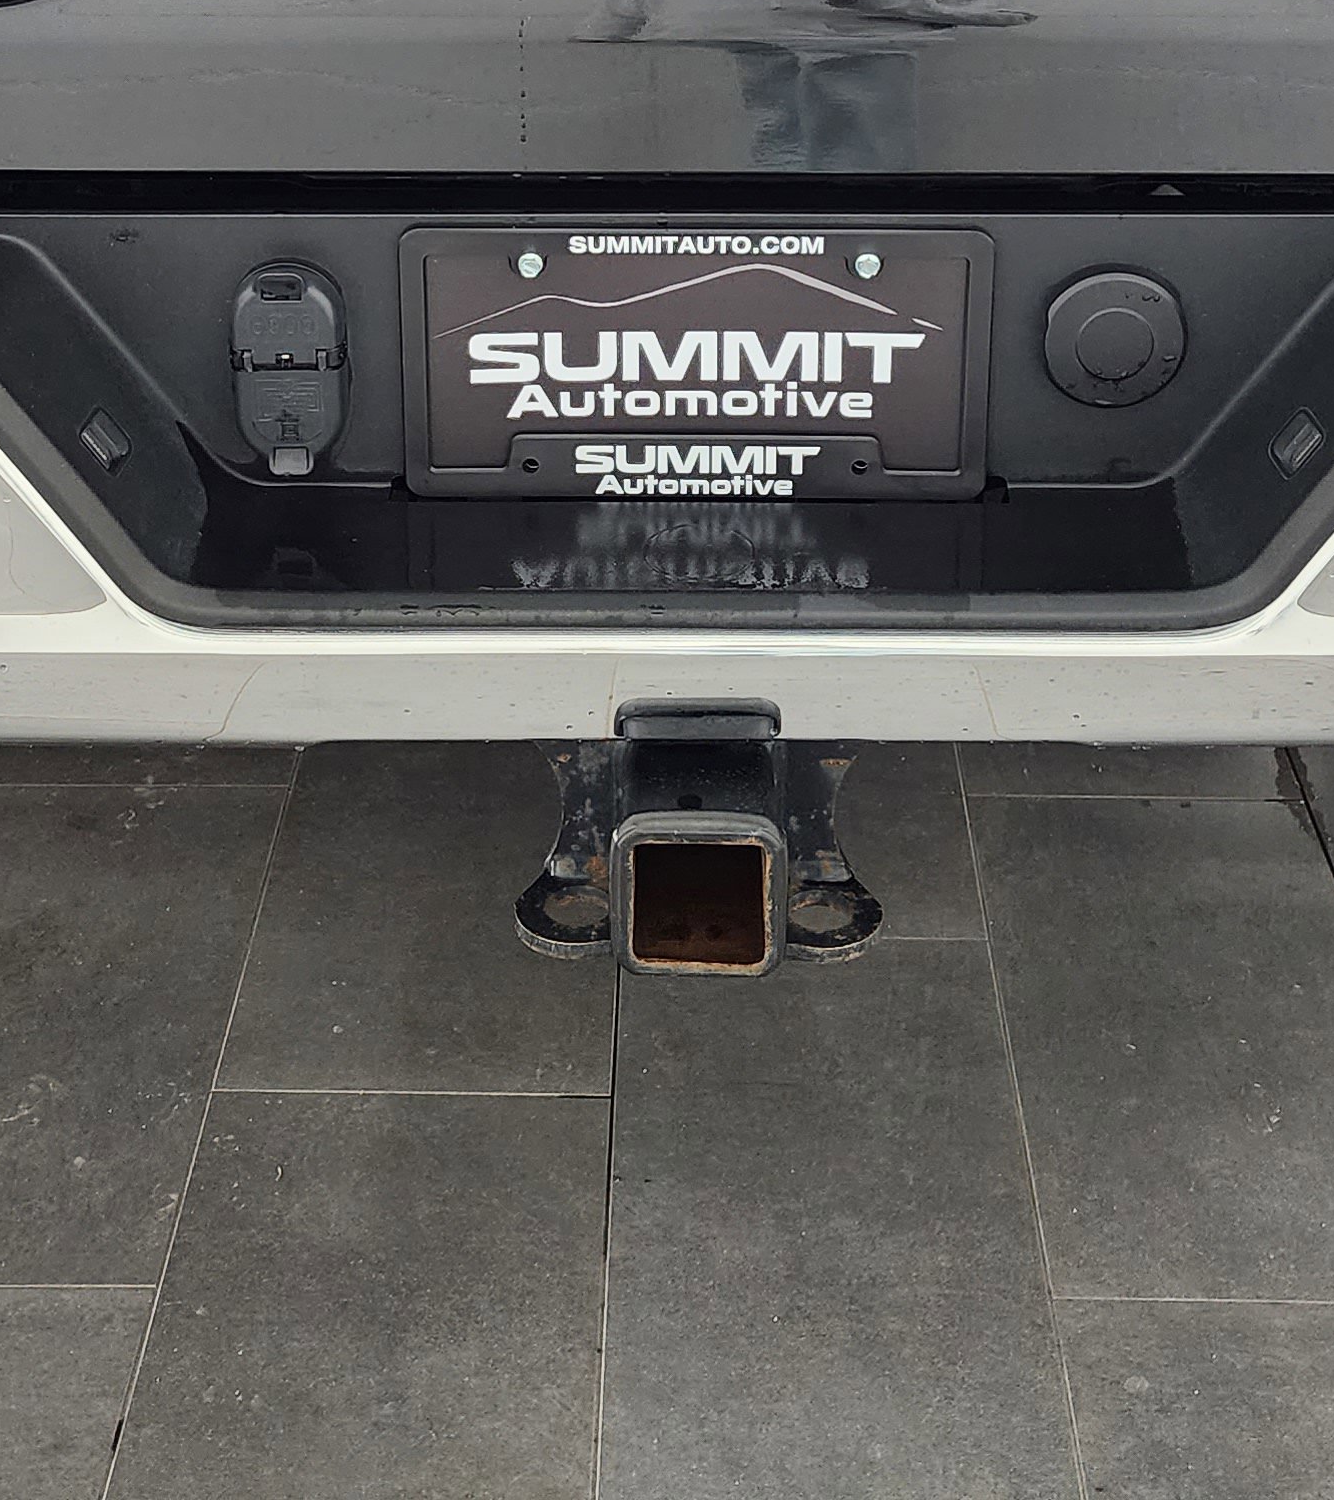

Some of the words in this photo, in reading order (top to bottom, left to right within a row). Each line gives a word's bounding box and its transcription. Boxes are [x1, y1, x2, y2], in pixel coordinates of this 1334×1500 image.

[568, 235, 825, 256] SUMMITAUTO.COM
[468, 331, 926, 384] SUMMIT
[507, 384, 873, 419] Automotive
[574, 445, 821, 475] SUMMIT
[595, 474, 794, 496] Automotive
